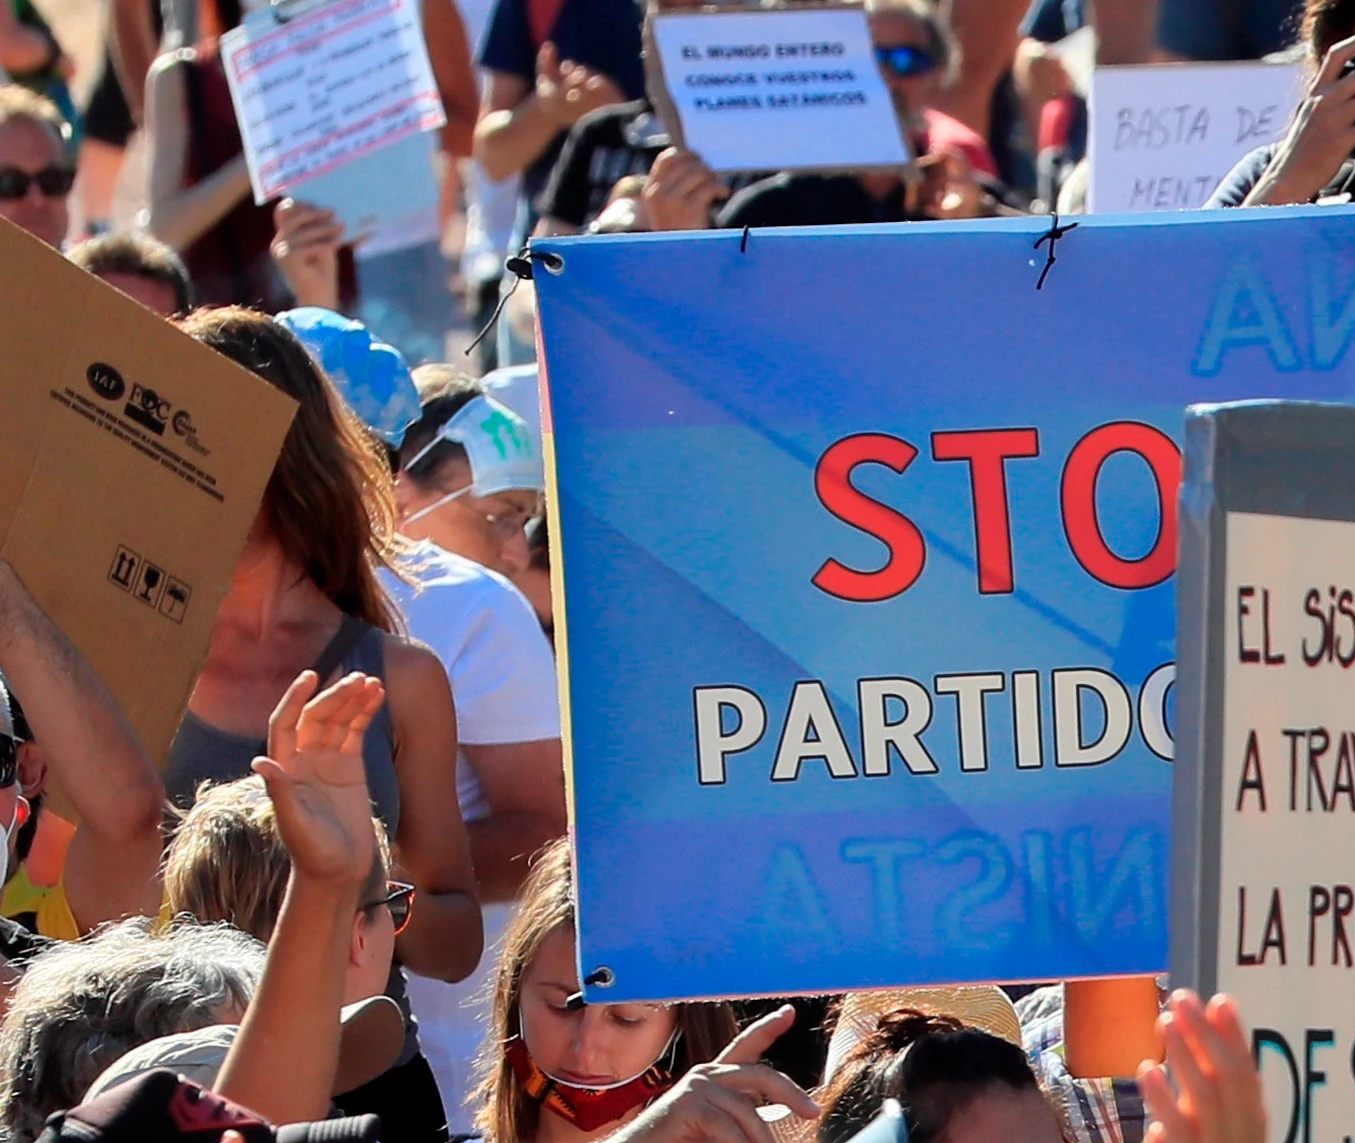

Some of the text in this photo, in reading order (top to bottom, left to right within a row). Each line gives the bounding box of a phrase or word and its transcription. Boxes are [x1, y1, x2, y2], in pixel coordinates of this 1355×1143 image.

[1114, 105, 1278, 150] BASTA DE
[1129, 175, 1222, 208] MENT
[811, 419, 1182, 602] STO
[1236, 585, 1286, 665] EL
[1235, 729, 1267, 812] A
[1236, 885, 1287, 967] LA
